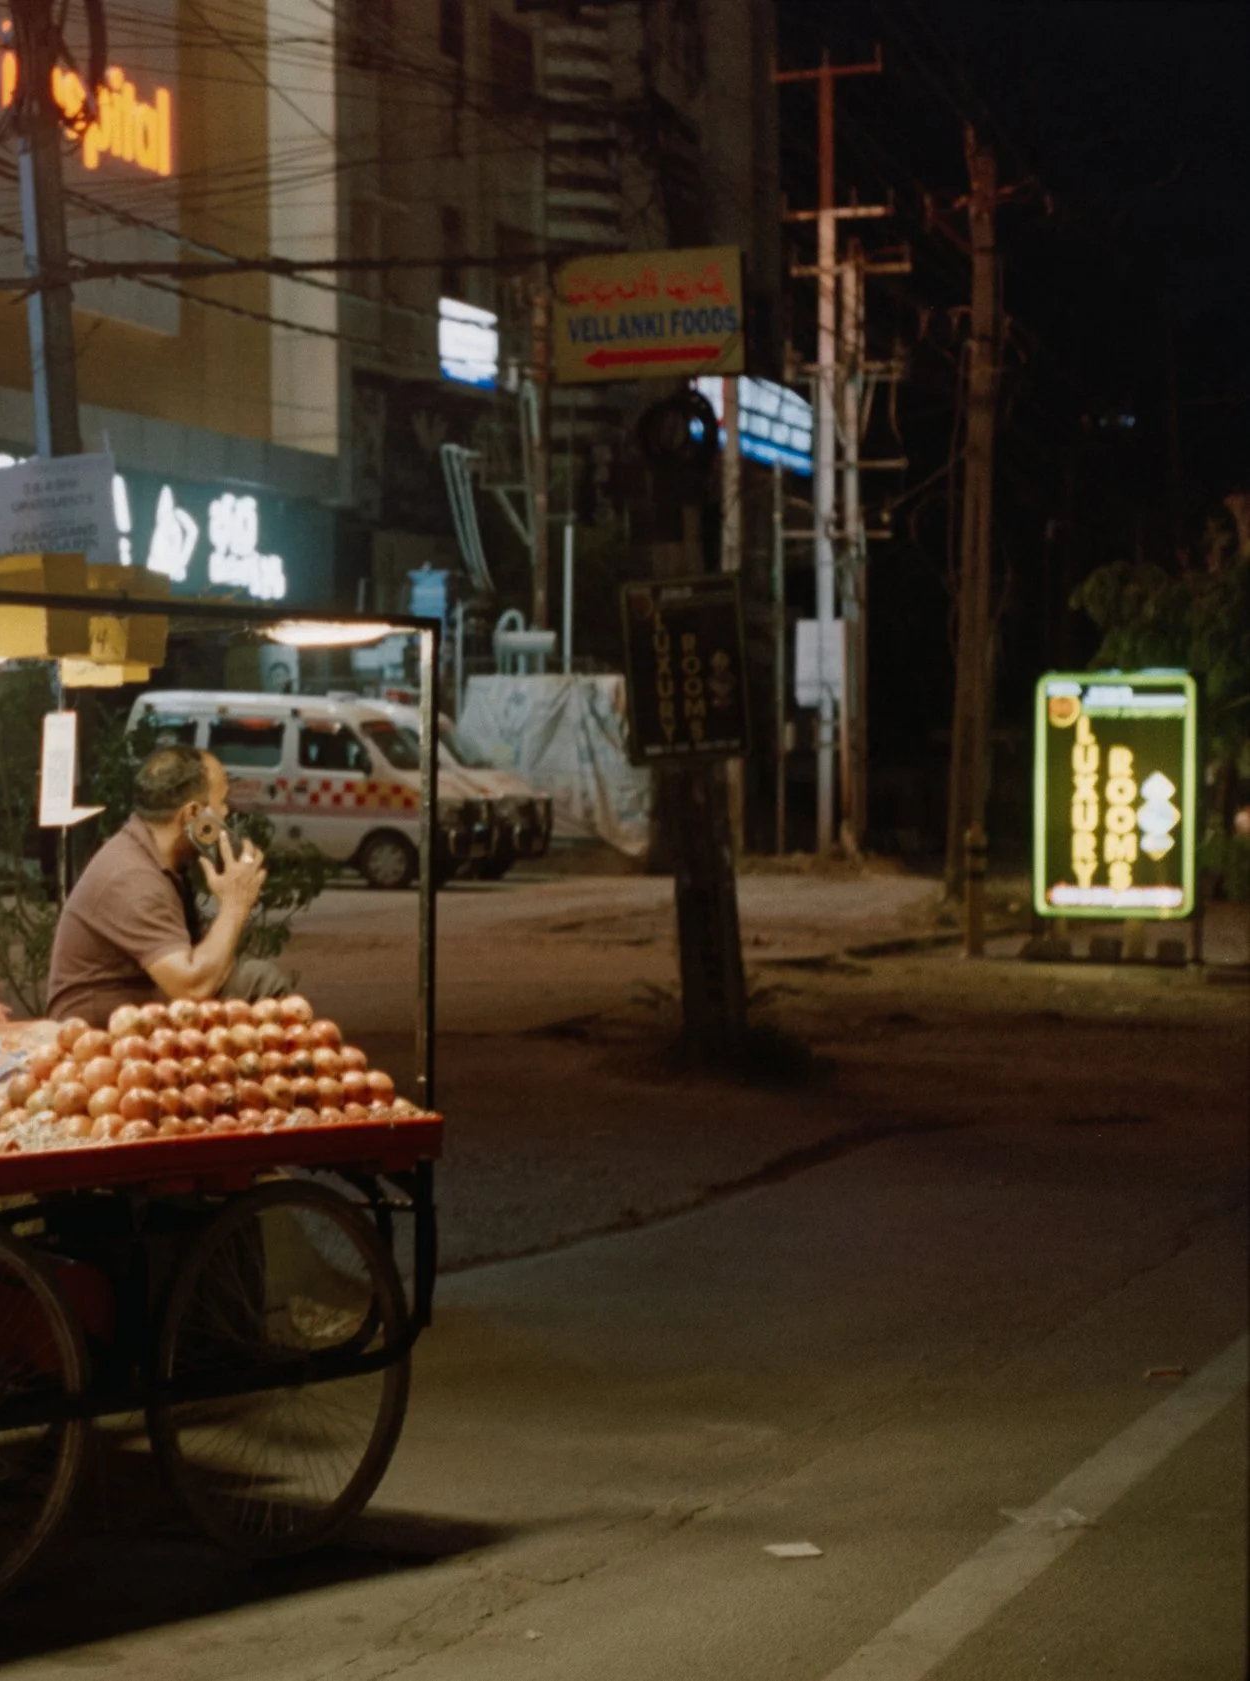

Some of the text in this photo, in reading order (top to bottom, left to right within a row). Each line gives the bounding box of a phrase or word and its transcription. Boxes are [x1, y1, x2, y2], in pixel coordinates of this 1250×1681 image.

[568, 307, 737, 343] VELLANKI FOODS
[1071, 716, 1099, 888] LUXURY
[1104, 746, 1137, 893] ROOMS
